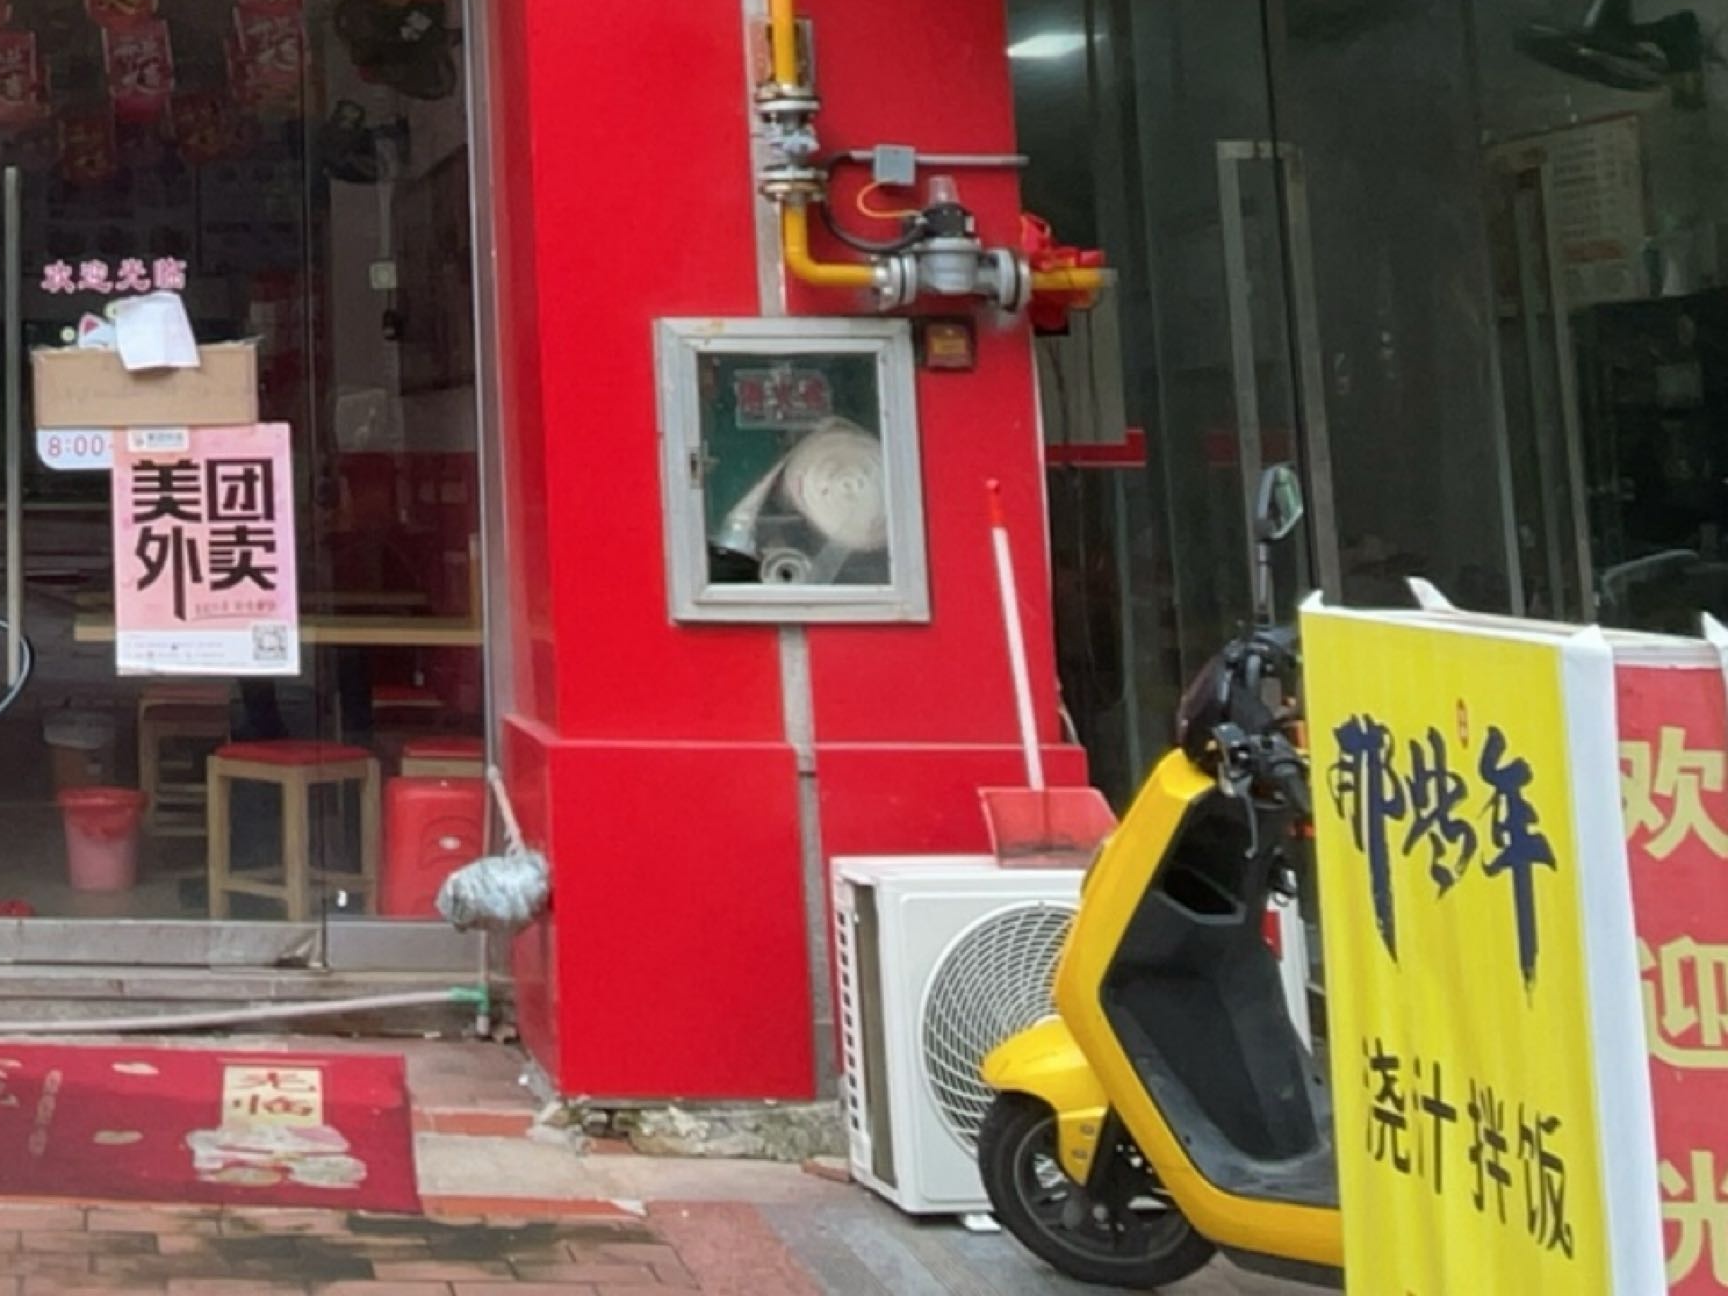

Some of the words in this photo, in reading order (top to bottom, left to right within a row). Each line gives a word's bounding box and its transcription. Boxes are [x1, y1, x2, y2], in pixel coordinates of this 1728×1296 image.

[41, 257, 188, 295] 欢迎光临
[131, 458, 276, 525] 美团
[135, 525, 279, 621] 外卖
[1329, 710, 1559, 1010] 那些年
[1361, 1036, 1575, 1262] 浇汁拌饭
